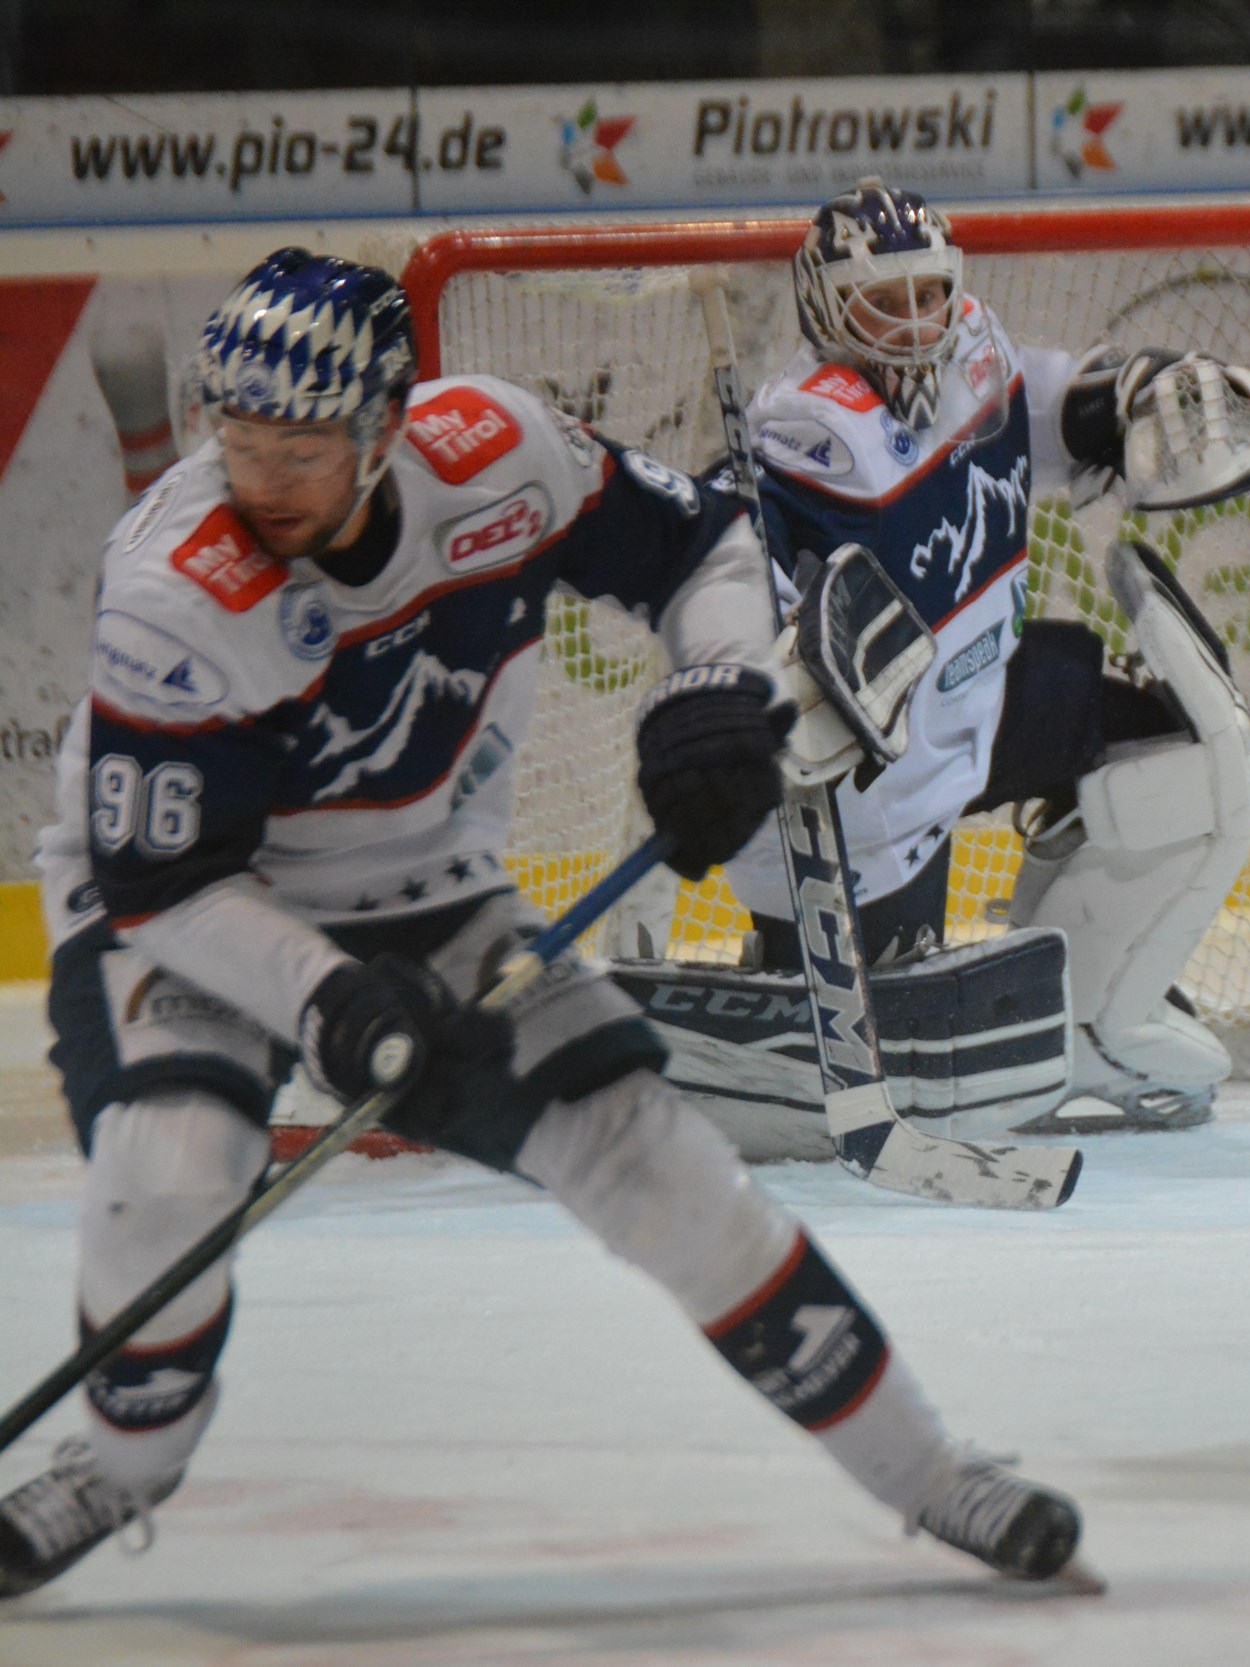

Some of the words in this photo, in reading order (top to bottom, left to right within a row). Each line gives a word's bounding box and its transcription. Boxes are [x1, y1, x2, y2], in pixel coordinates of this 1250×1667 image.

[70, 112, 507, 192] www.pio-24.de
[692, 89, 997, 155] Piotrowski
[410, 408, 467, 442] My
[431, 408, 508, 462] Tirol
[92, 753, 203, 855] 96
[649, 983, 814, 1024] CCM
